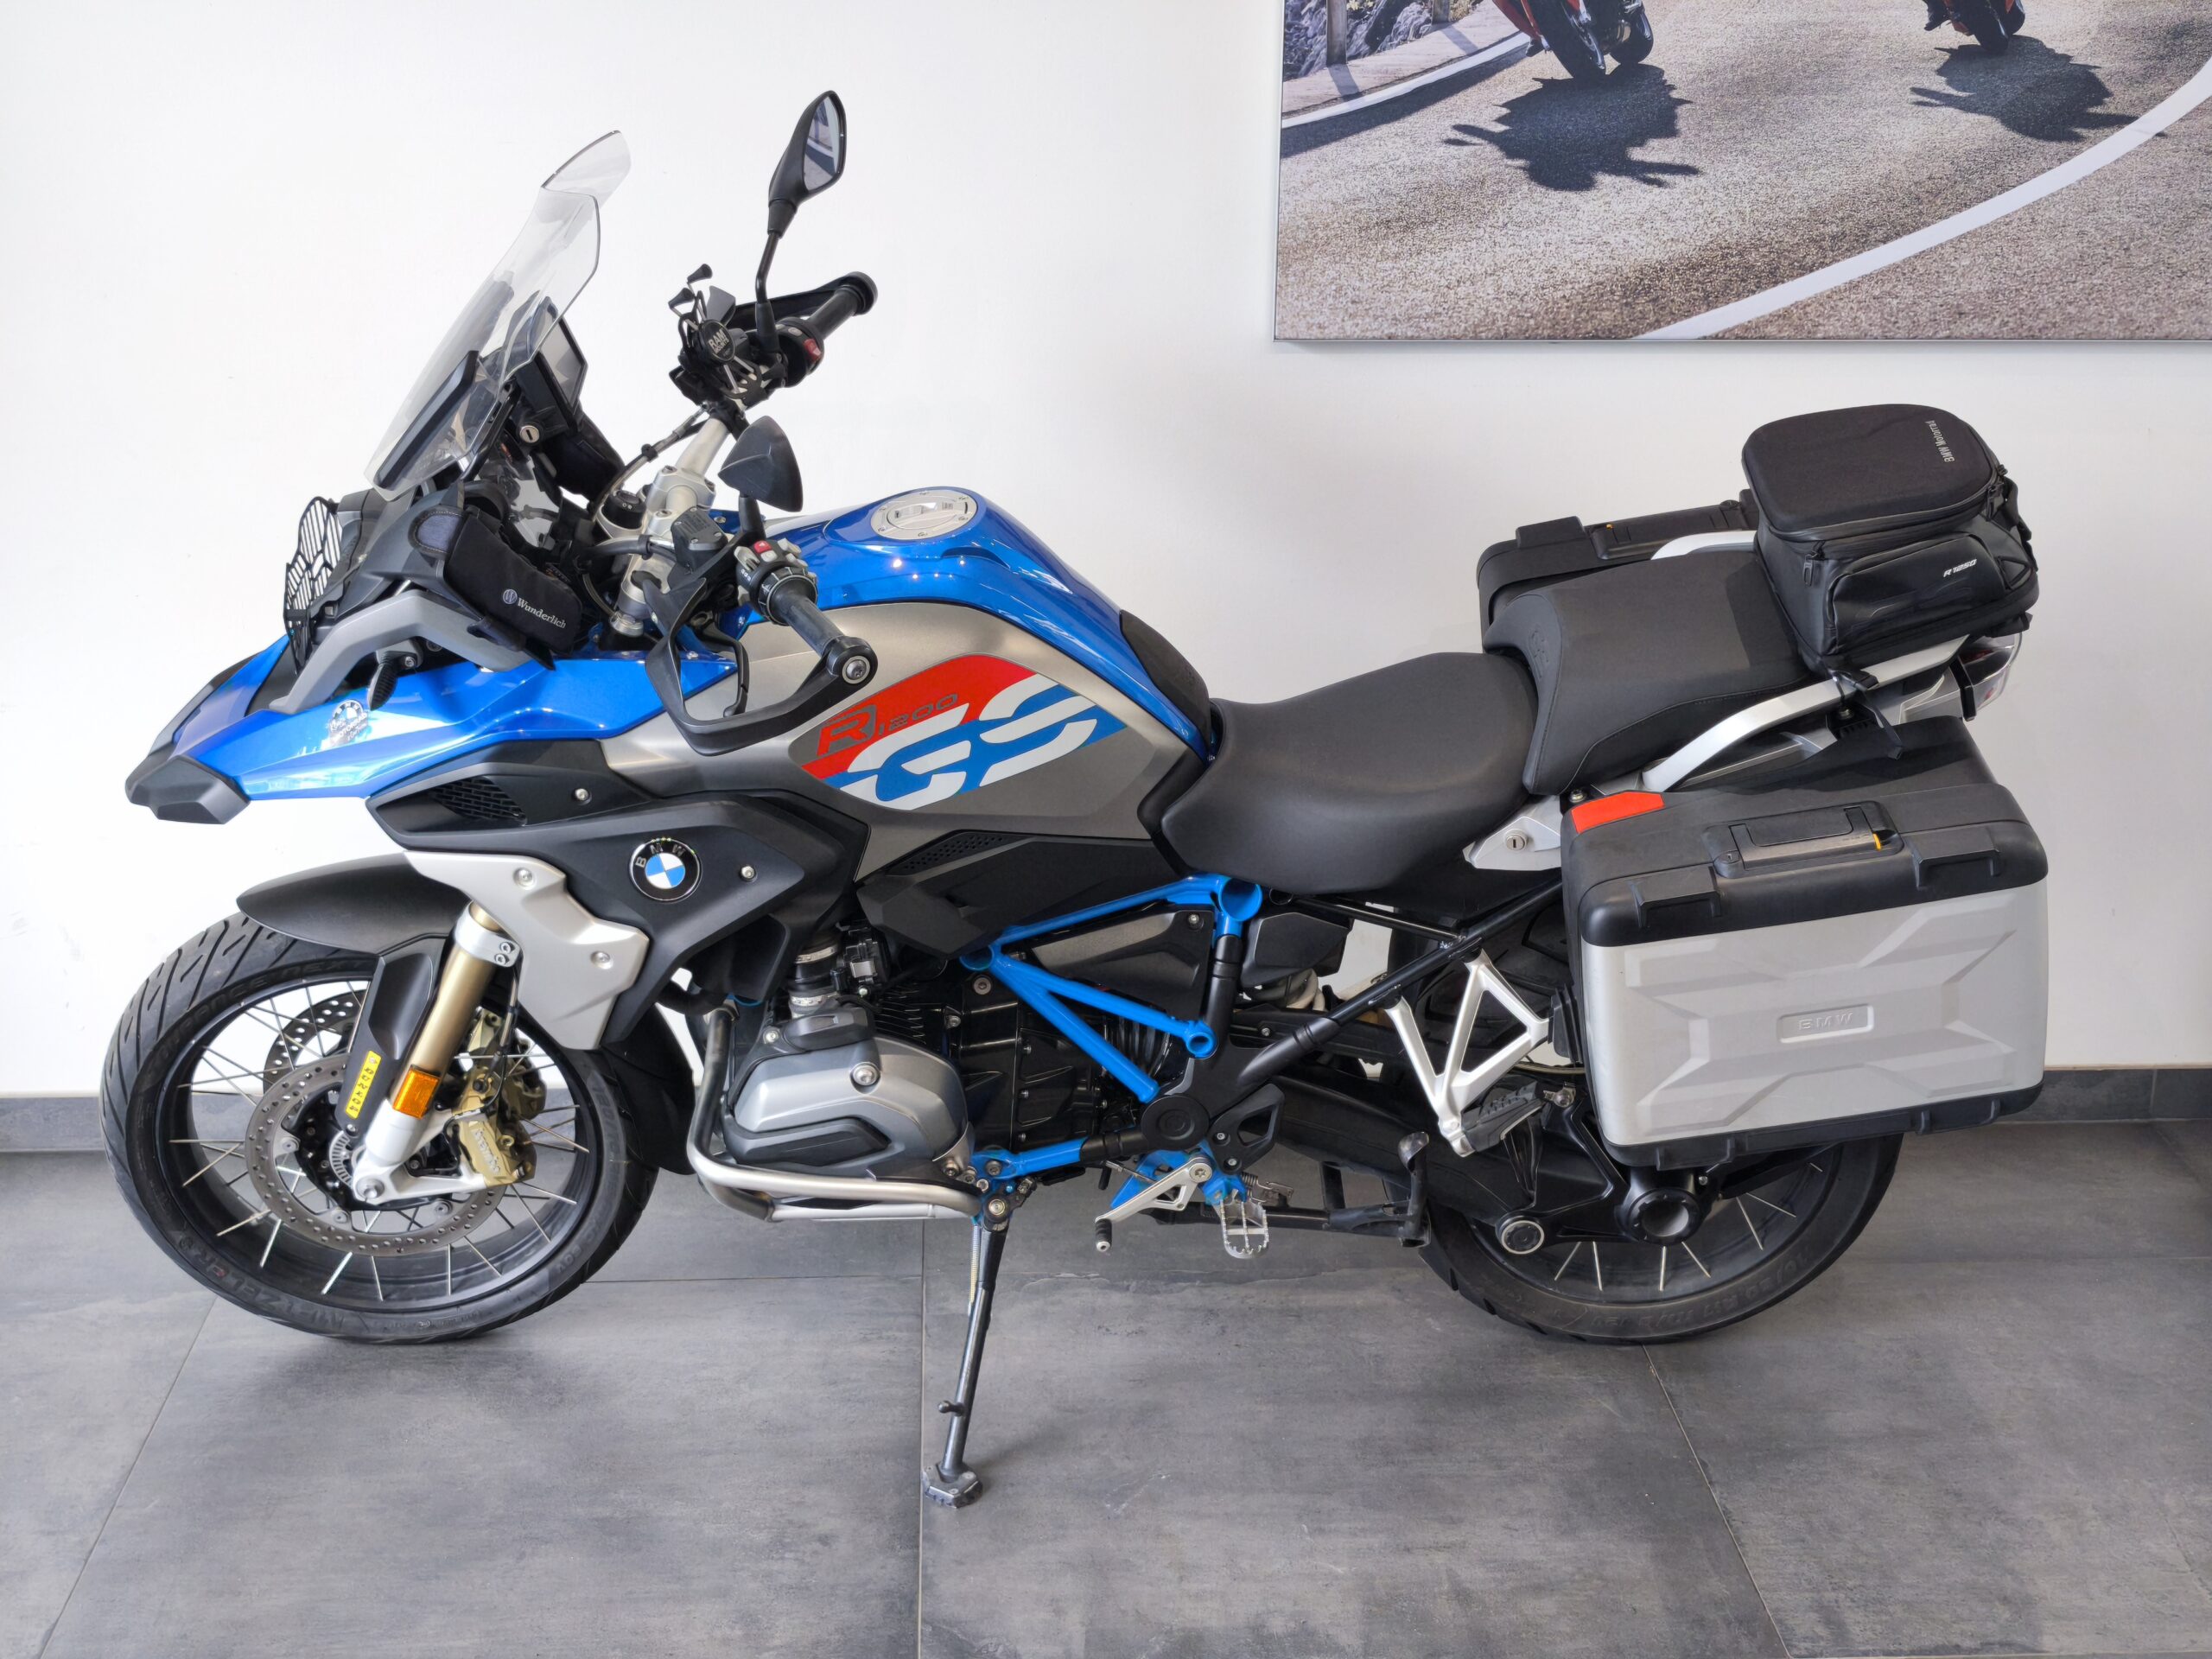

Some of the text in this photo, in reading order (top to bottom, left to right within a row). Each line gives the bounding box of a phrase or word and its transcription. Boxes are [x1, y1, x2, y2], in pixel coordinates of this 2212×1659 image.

[709, 327, 728, 350] RAM
[1924, 420, 1955, 462] BMW Motorrad
[518, 597, 567, 629] Wunderlich
[839, 673, 1098, 810] GS
[634, 842, 686, 868] BMW
[1798, 1012, 1853, 1030] BMW
